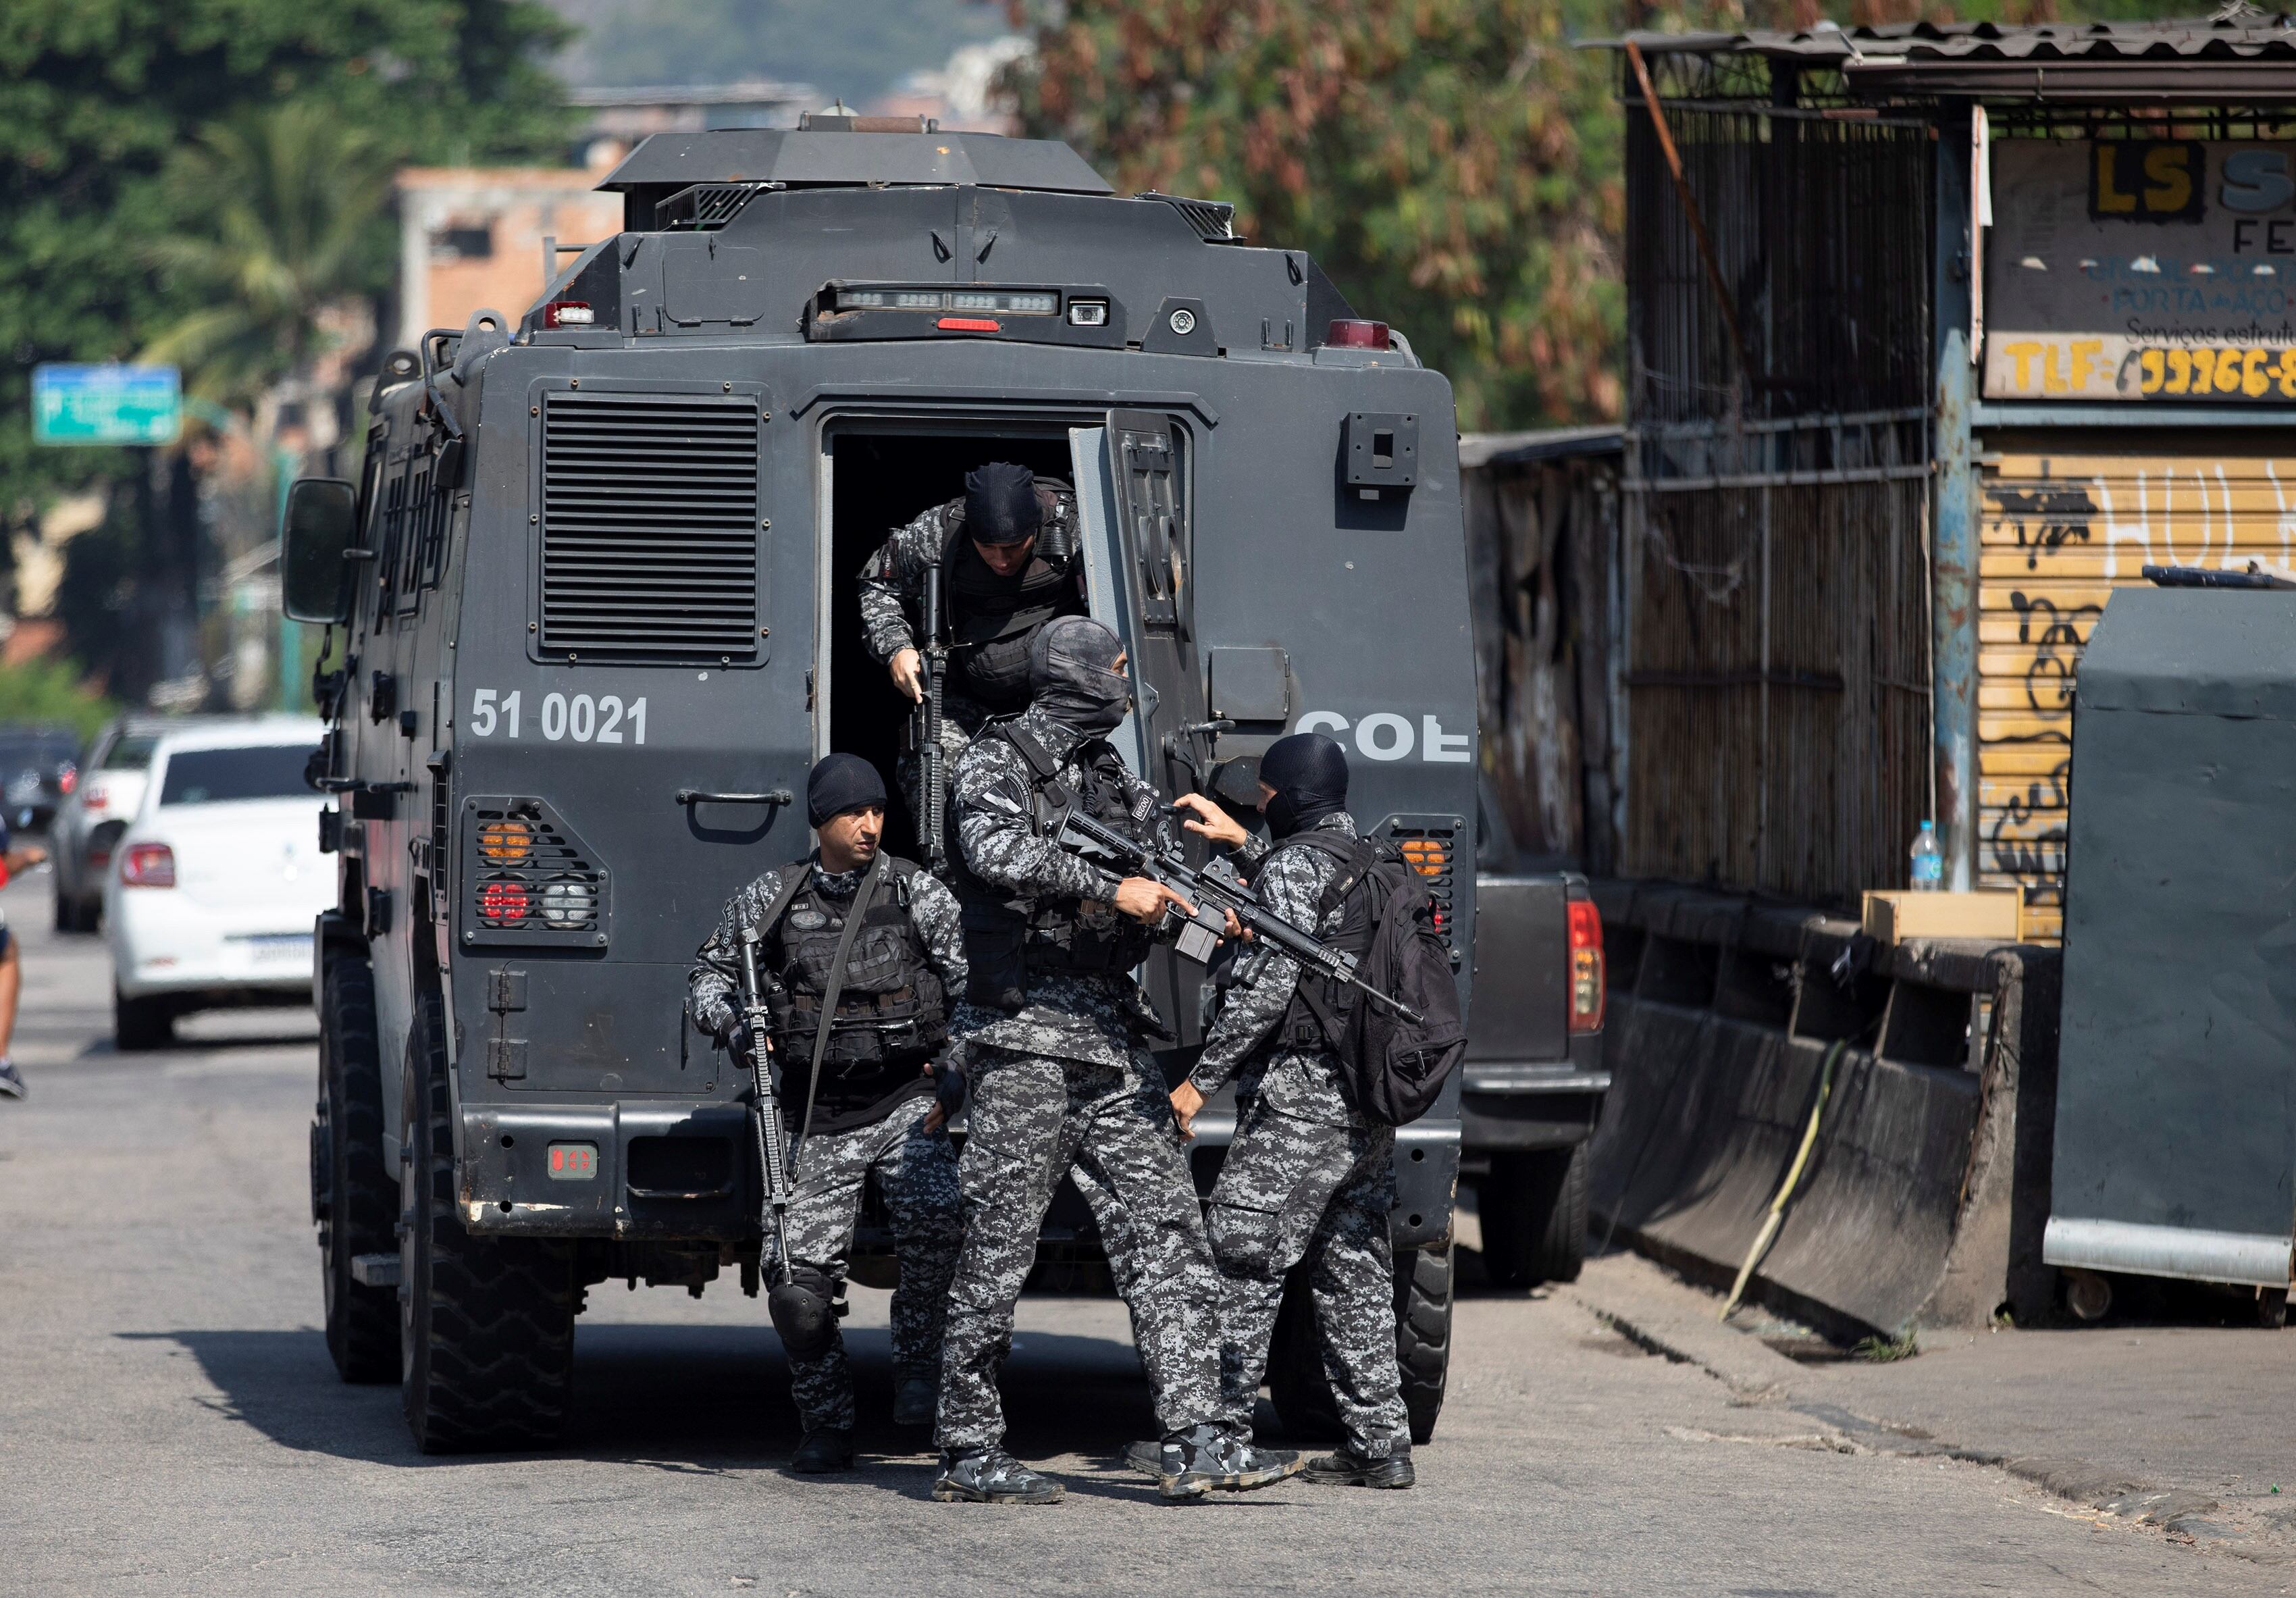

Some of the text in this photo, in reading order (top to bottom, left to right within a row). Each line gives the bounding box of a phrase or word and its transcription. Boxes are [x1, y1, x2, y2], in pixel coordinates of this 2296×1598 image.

[2096, 144, 2193, 214] LS
[2234, 218, 2295, 255] FE
[2112, 287, 2208, 315] PORTA
[2230, 286, 2287, 318] AÇO
[2126, 316, 2218, 349] Serviços
[471, 689, 646, 745] 51 0021
[1136, 797, 1149, 817] 0029
[723, 904, 733, 944] PATAMO
